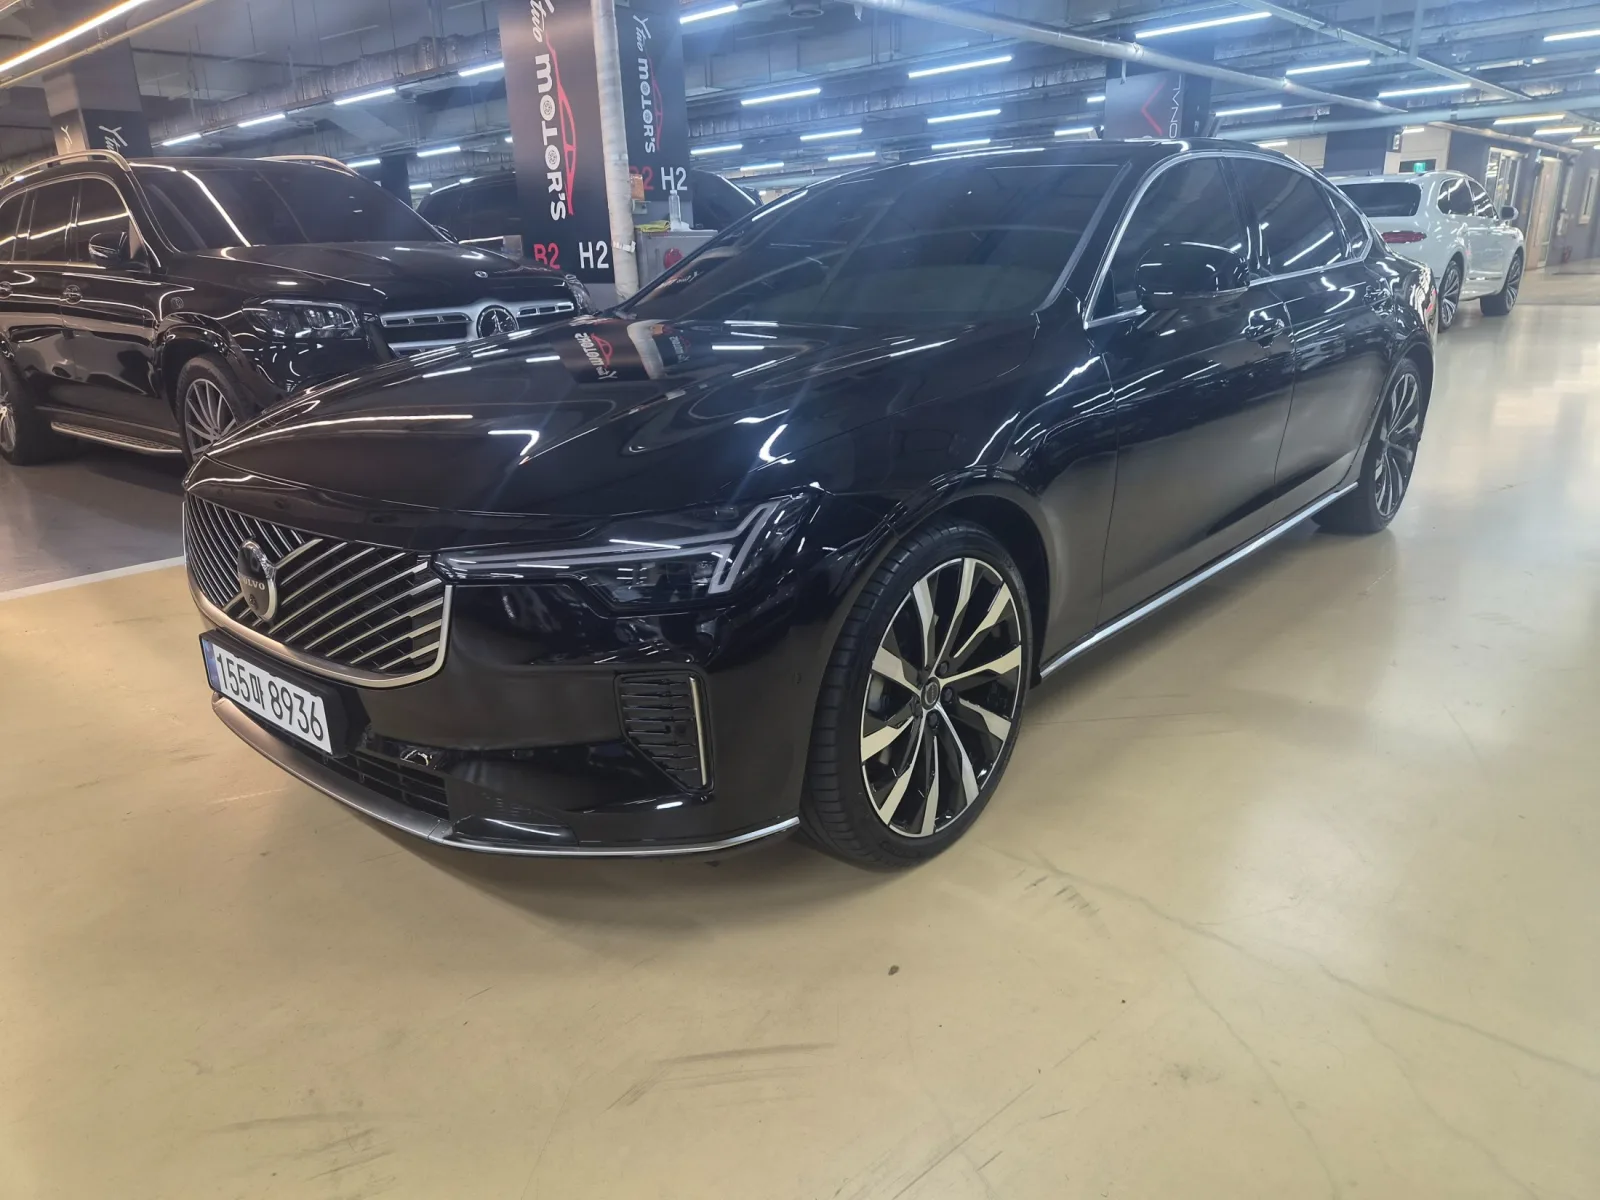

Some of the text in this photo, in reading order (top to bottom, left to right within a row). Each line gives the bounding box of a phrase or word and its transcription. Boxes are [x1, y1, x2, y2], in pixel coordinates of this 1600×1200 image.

[629, 165, 687, 190] 2 H2
[579, 240, 609, 269] H2
[217, 653, 324, 741] 155마 8936
